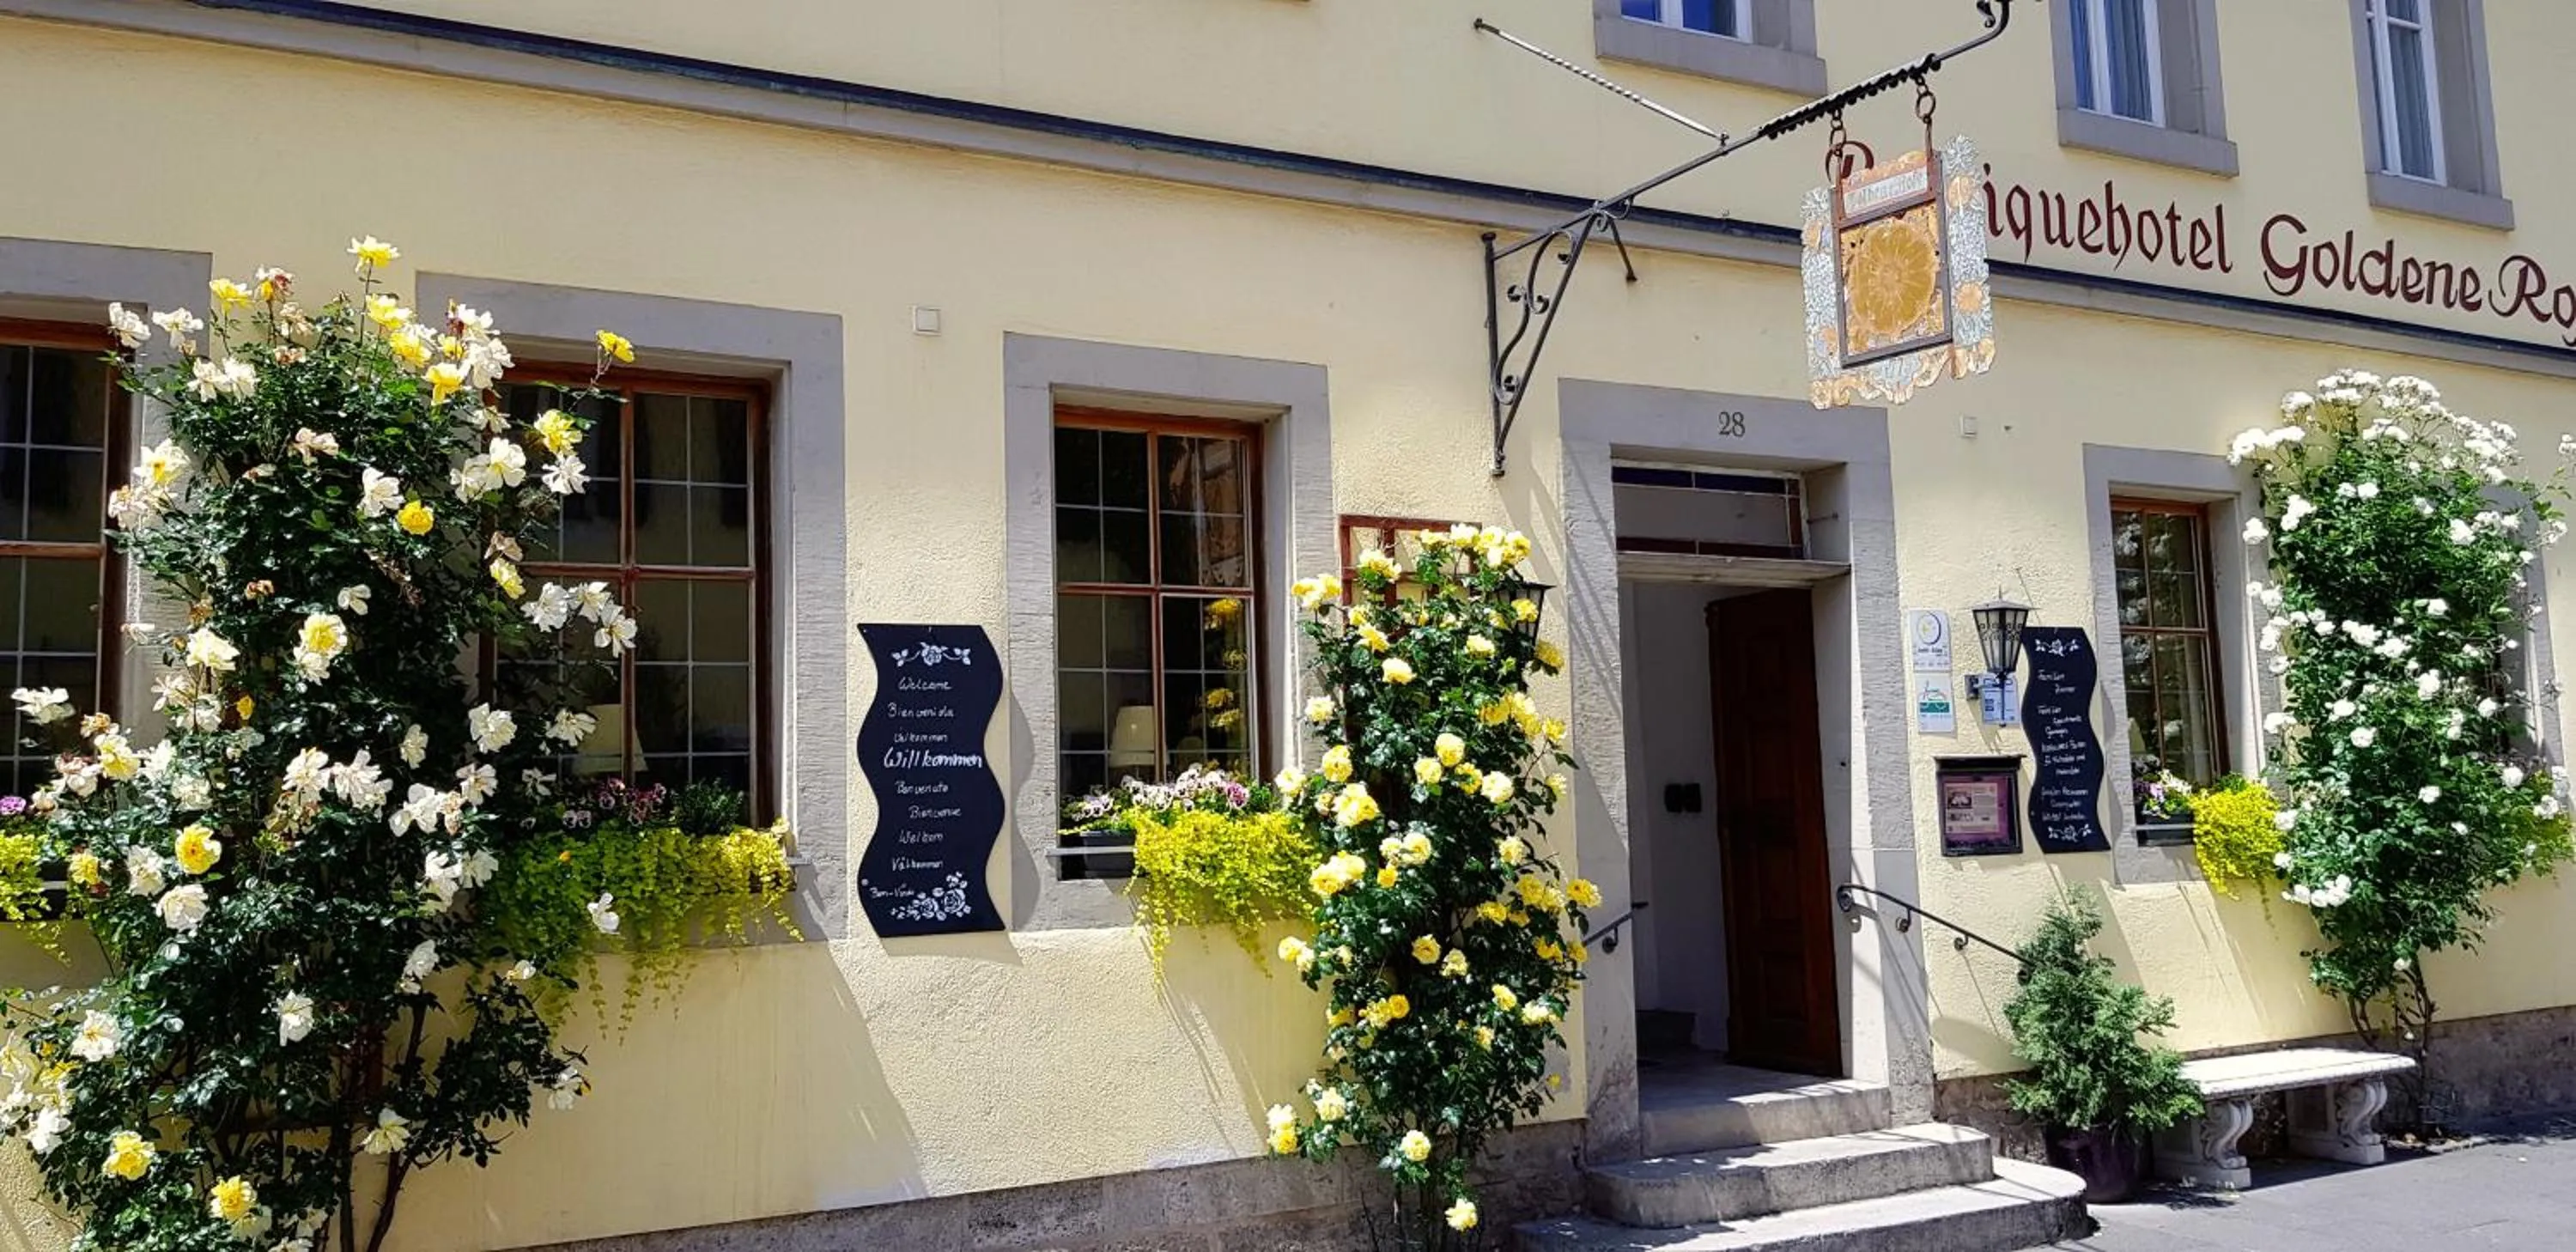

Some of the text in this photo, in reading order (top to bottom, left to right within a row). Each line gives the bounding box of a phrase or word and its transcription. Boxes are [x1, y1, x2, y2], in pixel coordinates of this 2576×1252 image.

[2259, 213, 2482, 312] Goldene
[2488, 255, 2576, 348] Ro
[1718, 410, 1746, 437] 28
[897, 676, 953, 690] Welcome
[883, 746, 983, 769] Willkommen
